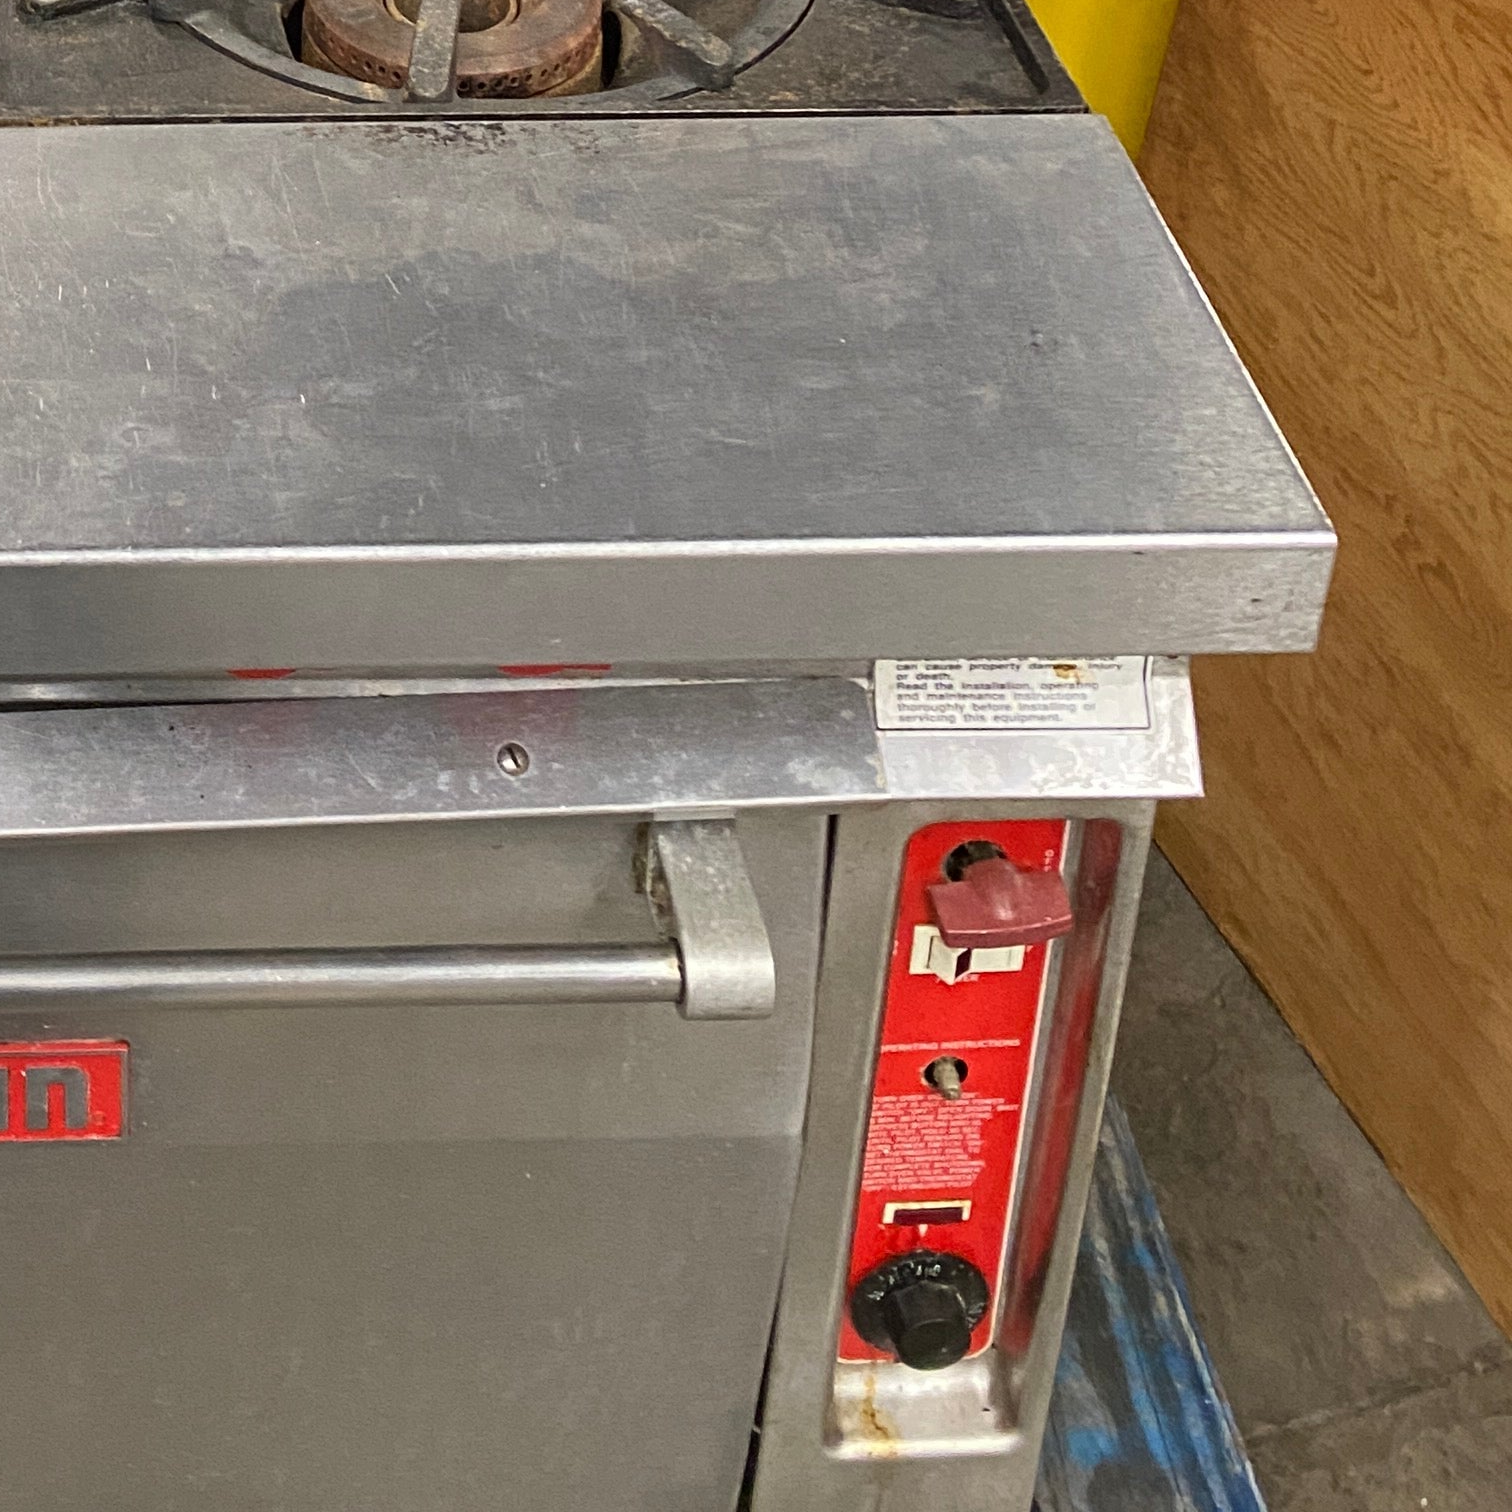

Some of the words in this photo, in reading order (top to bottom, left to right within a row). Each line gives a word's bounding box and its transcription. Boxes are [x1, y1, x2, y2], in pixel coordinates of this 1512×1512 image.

[895, 663, 917, 671] can
[924, 663, 962, 671] cause
[969, 662, 1021, 672] property
[895, 673, 908, 681] or
[896, 682, 928, 690] Read
[934, 682, 954, 690] the
[896, 693, 920, 701] and
[926, 692, 1006, 701] maintenance
[1013, 692, 1088, 701] instructions
[897, 703, 966, 713] thoroughly
[971, 702, 1012, 711] before
[1018, 702, 1077, 713] installing
[898, 714, 957, 724] servicing
[963, 713, 986, 722] this
[992, 713, 1063, 724] equipment.
